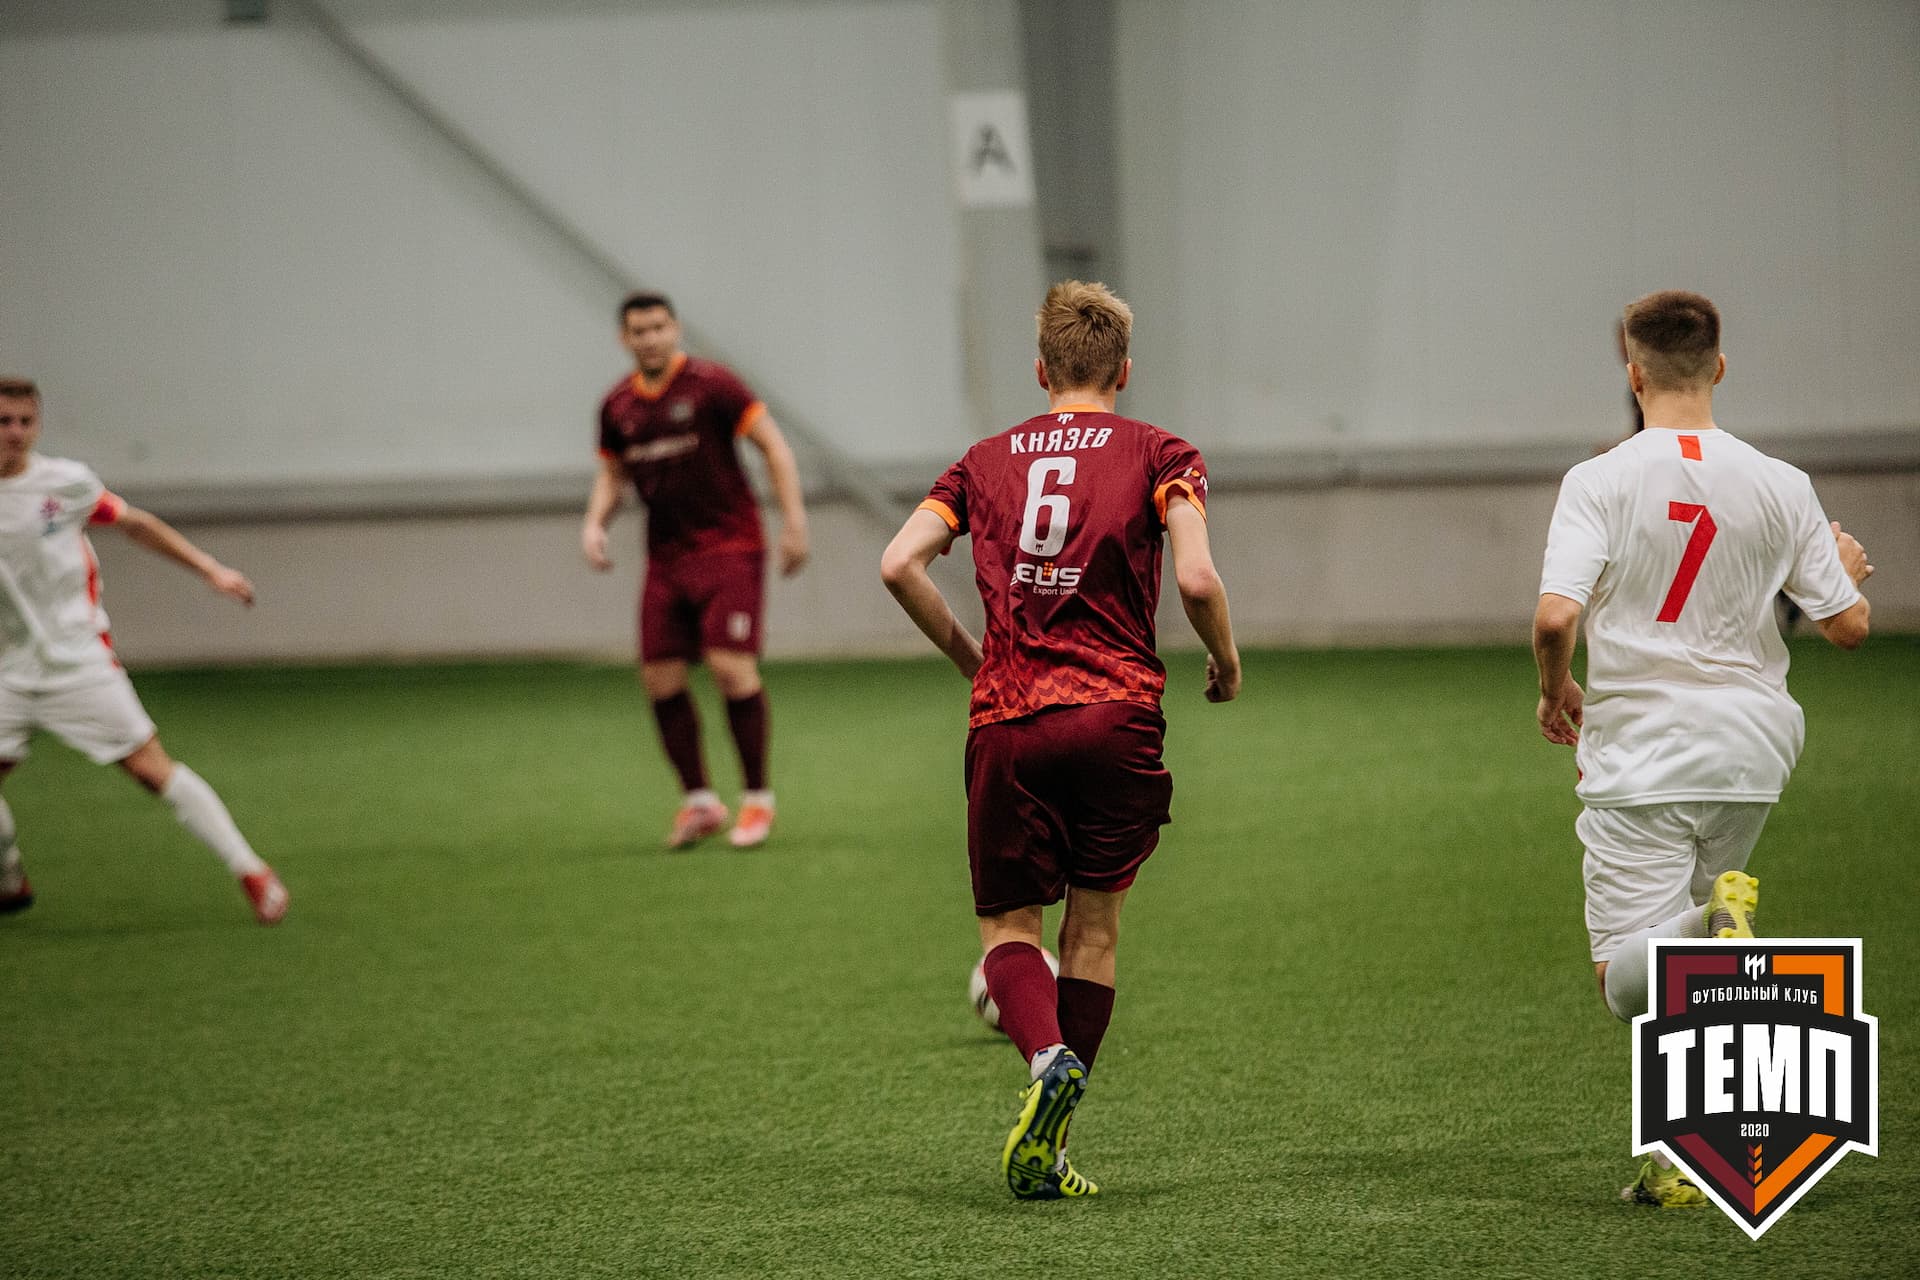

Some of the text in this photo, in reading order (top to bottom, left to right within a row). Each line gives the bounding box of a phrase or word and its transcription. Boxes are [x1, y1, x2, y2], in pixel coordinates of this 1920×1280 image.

[967, 123, 1018, 178] A
[1010, 427, 1113, 455] КНЯЗЕВ
[1019, 456, 1076, 557] 6
[1656, 501, 1718, 623] 7
[1033, 585, 1058, 596] Export
